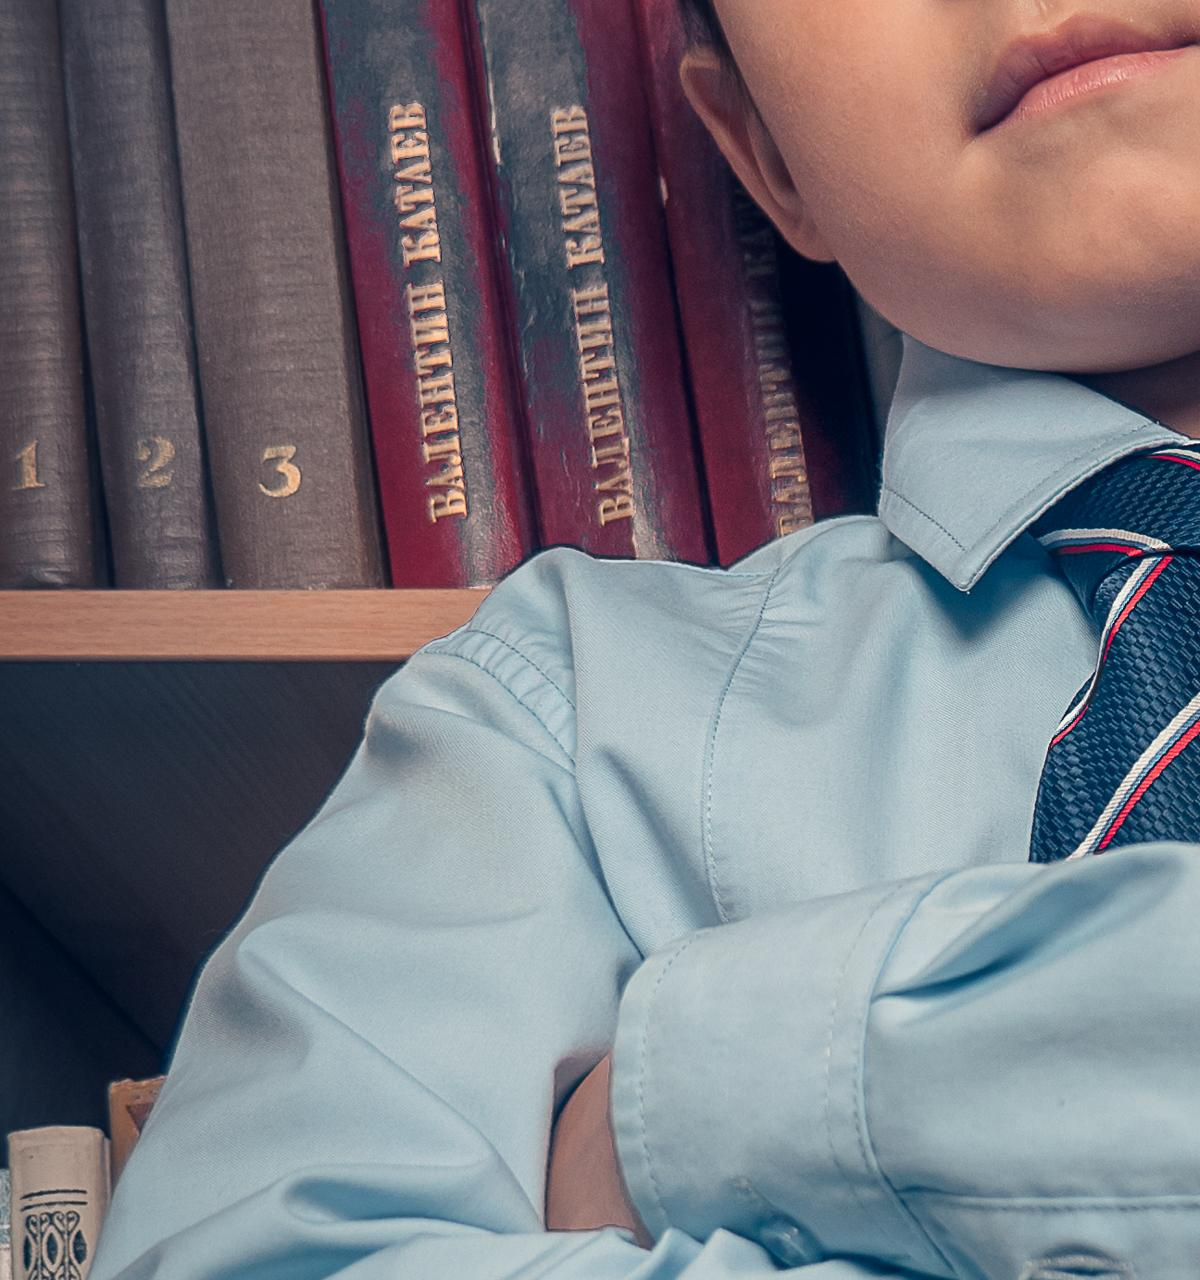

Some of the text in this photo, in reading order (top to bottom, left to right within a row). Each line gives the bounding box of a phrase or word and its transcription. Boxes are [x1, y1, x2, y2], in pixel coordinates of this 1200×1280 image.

[389, 102, 469, 523] ВАЛЕНТИН КАТАЕВ
[549, 105, 634, 526] ВАЛЕНТИН КАТАЕВ
[13, 440, 46, 491] 1
[136, 436, 176, 489] 2
[259, 445, 303, 499] 3
